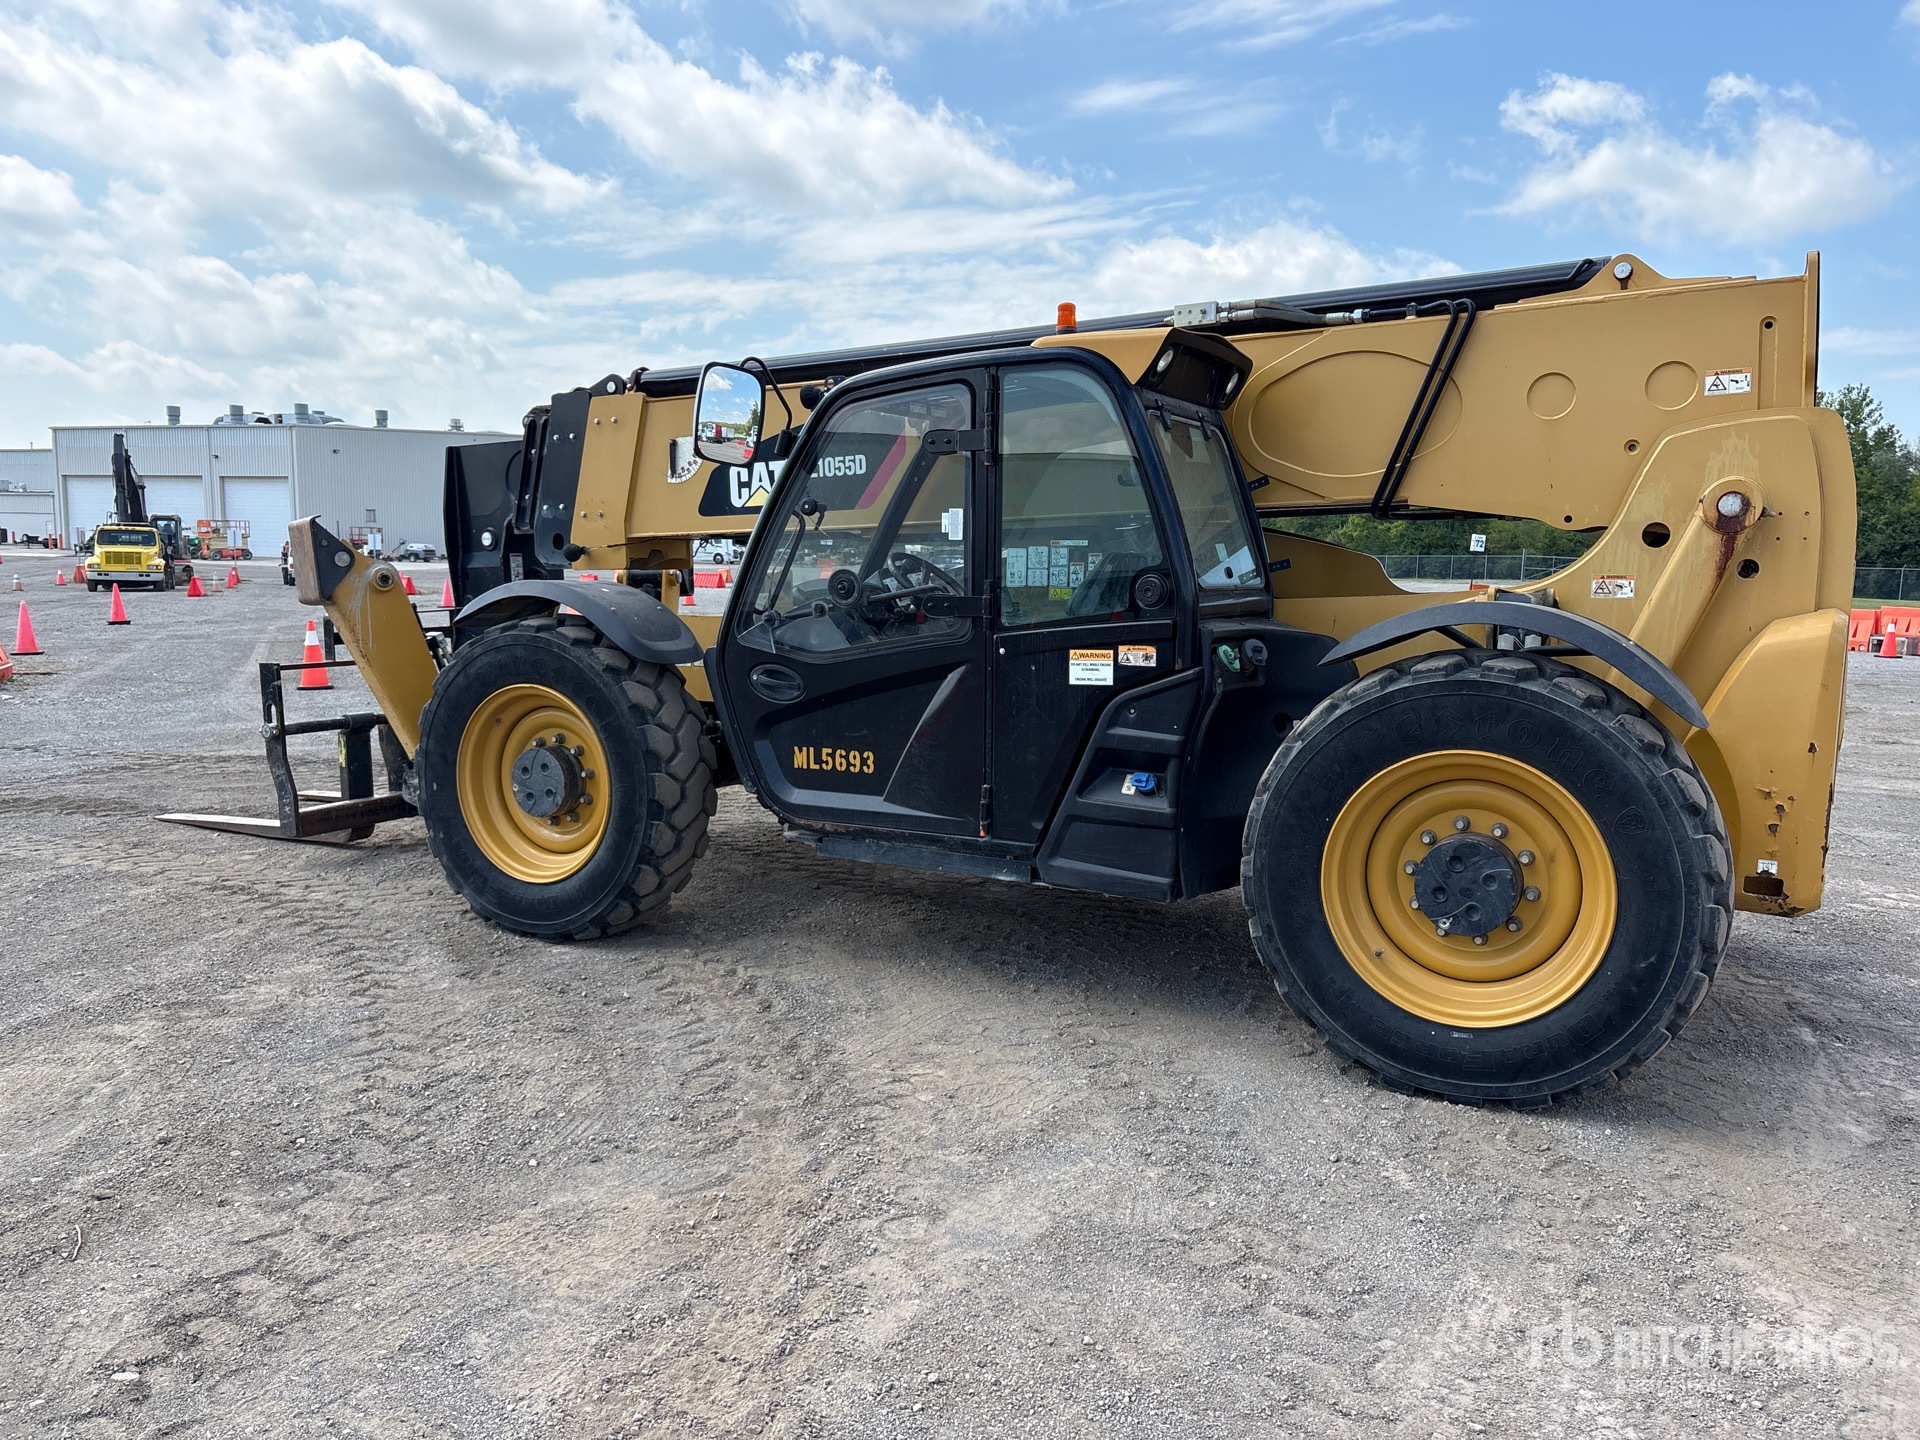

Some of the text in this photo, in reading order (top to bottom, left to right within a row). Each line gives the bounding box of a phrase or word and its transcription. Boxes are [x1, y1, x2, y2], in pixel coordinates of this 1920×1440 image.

[729, 459, 786, 508] CAT
[810, 454, 867, 479] 1055D
[1475, 539, 1484, 548] 72
[793, 746, 875, 774] ML5693
